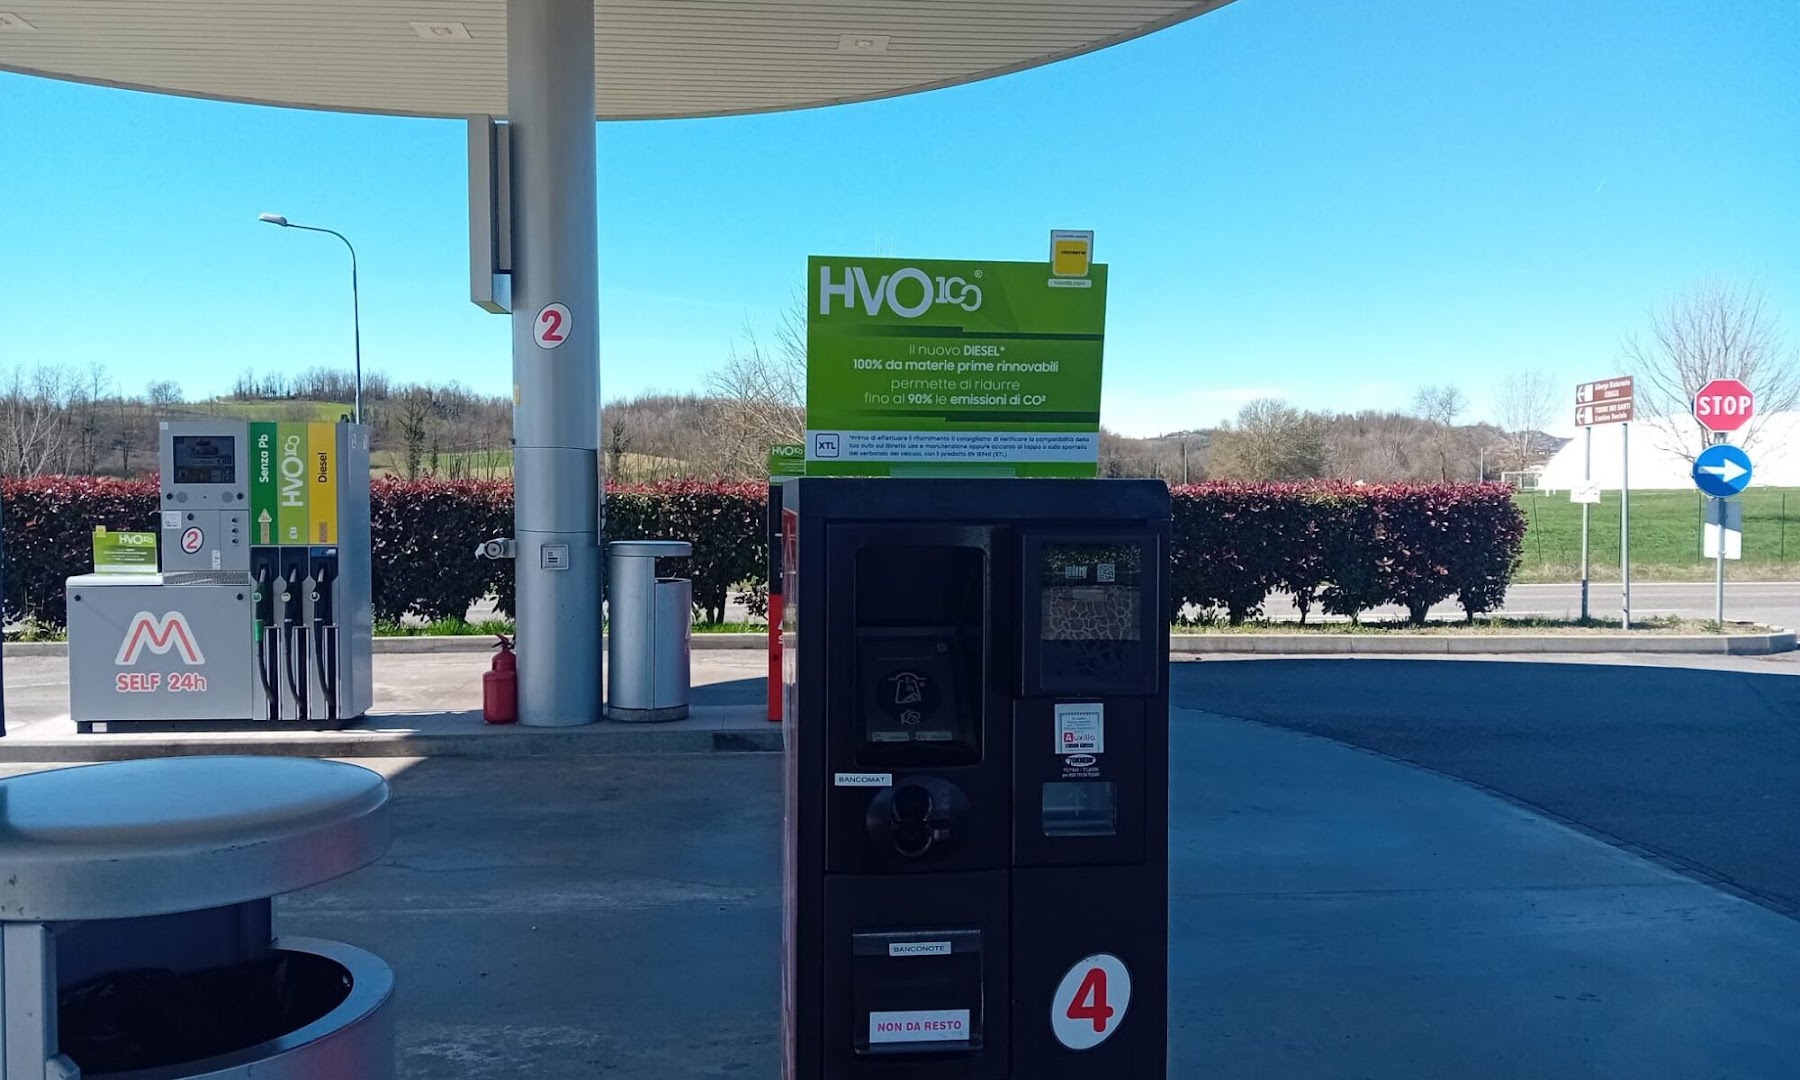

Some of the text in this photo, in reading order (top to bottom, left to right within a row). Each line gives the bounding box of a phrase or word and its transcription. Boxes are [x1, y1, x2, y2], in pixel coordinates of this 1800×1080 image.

[541, 309, 563, 341] 2
[909, 344, 915, 355] Il
[918, 347, 960, 356] nuovo
[853, 359, 1059, 374] 100% da materie prime rinnovabili
[891, 379, 1021, 391] permette di ridurre
[864, 392, 889, 404] fino
[893, 393, 905, 404] al
[908, 394, 932, 404] 90%
[936, 394, 947, 404] le
[950, 394, 1007, 405] emissioni
[1009, 394, 1021, 405] di
[1699, 395, 1751, 415] STOP
[818, 442, 837, 450] XTL
[258, 434, 269, 483] Senza Pb
[318, 452, 328, 483] Diesel
[186, 531, 199, 550] 2
[116, 673, 207, 692] SELF 24h
[893, 945, 945, 953] BANCONOTE
[1066, 967, 1114, 1033] 4
[877, 1020, 962, 1032] NON DA RESTO
